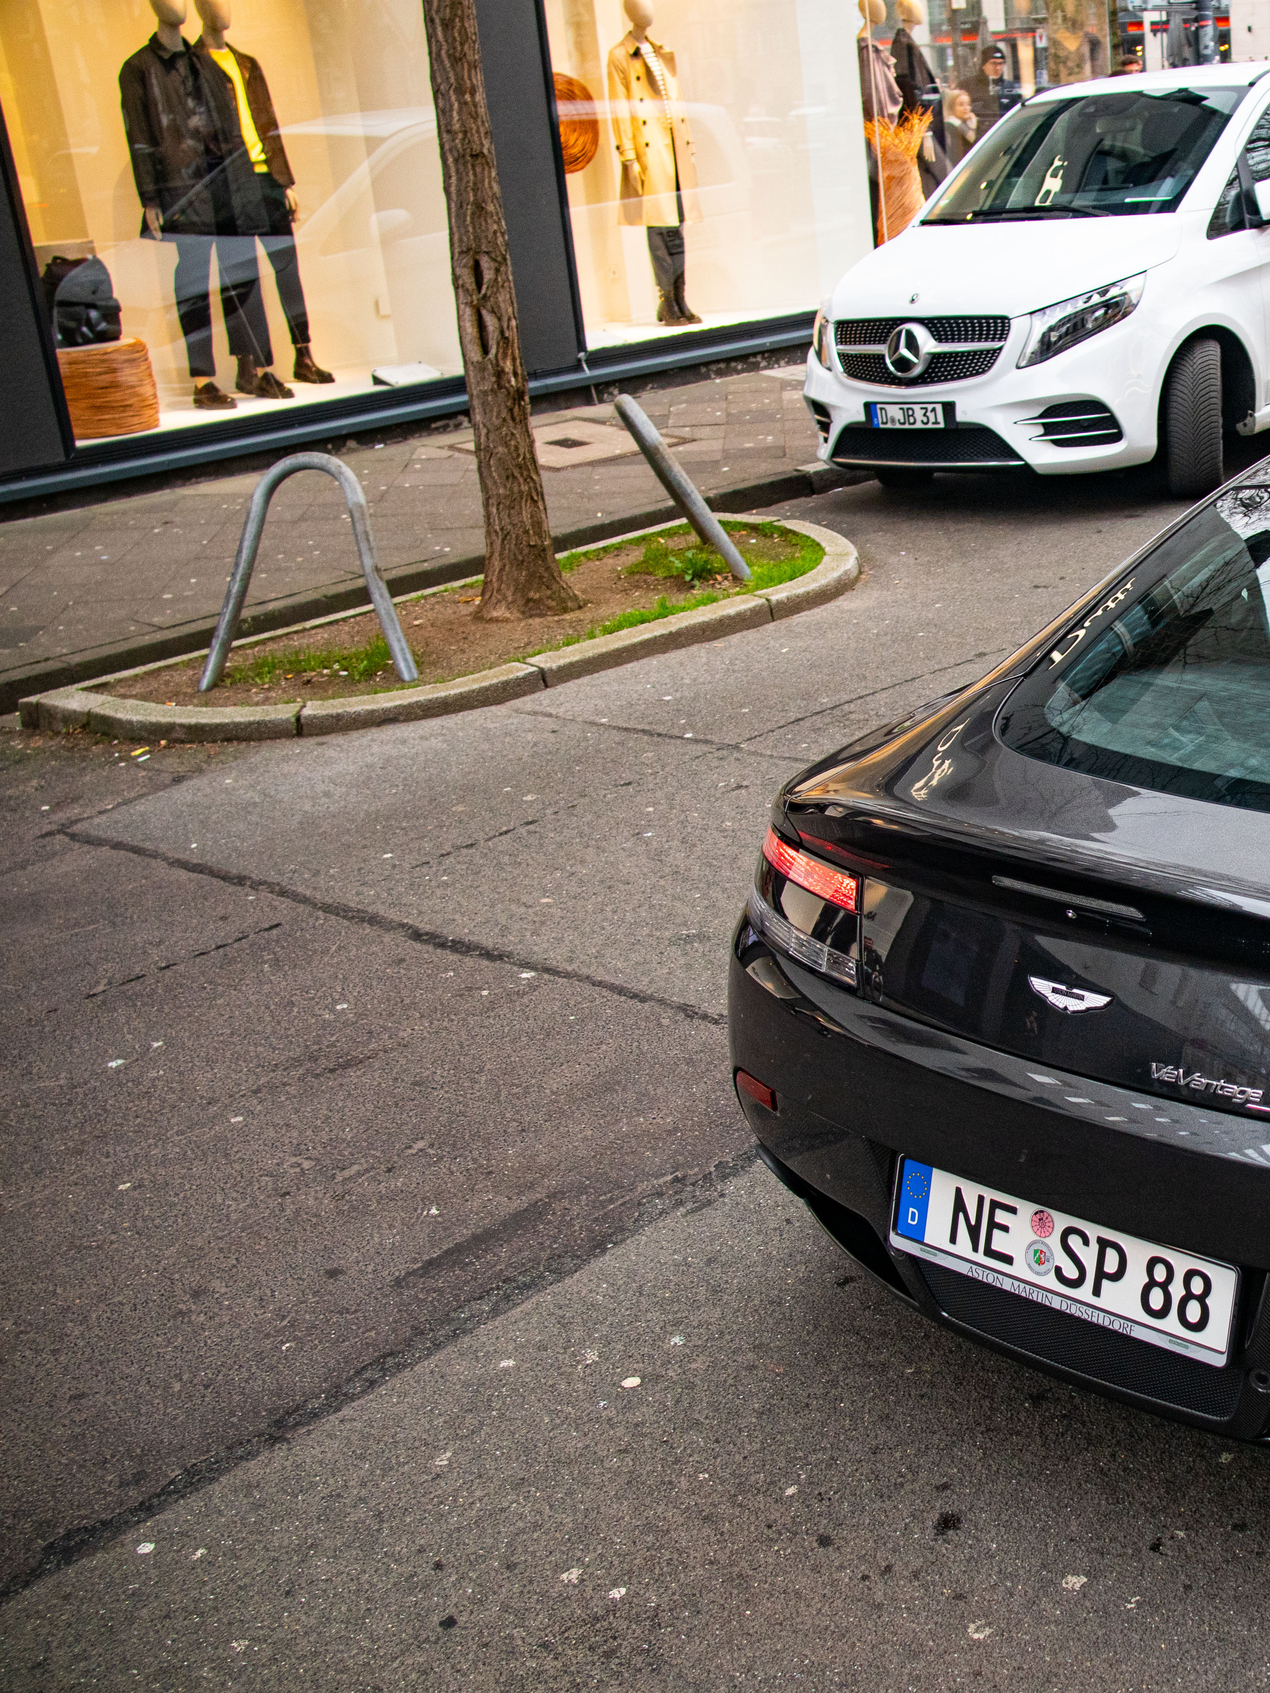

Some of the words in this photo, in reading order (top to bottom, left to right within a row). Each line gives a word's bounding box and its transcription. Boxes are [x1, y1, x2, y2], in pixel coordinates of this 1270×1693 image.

[879, 407, 888, 425] D
[897, 407, 916, 425] JB
[920, 406, 941, 425] 31
[1178, 1069, 1264, 1103] Vantage
[908, 1207, 918, 1225] D
[949, 1186, 1018, 1266] NE
[1054, 1226, 1128, 1298] SP
[1140, 1255, 1212, 1333] 88
[966, 1265, 1004, 1289] ASTON
[1009, 1282, 1054, 1306] MARTIN
[1059, 1298, 1135, 1336] DÜSSELDORF
